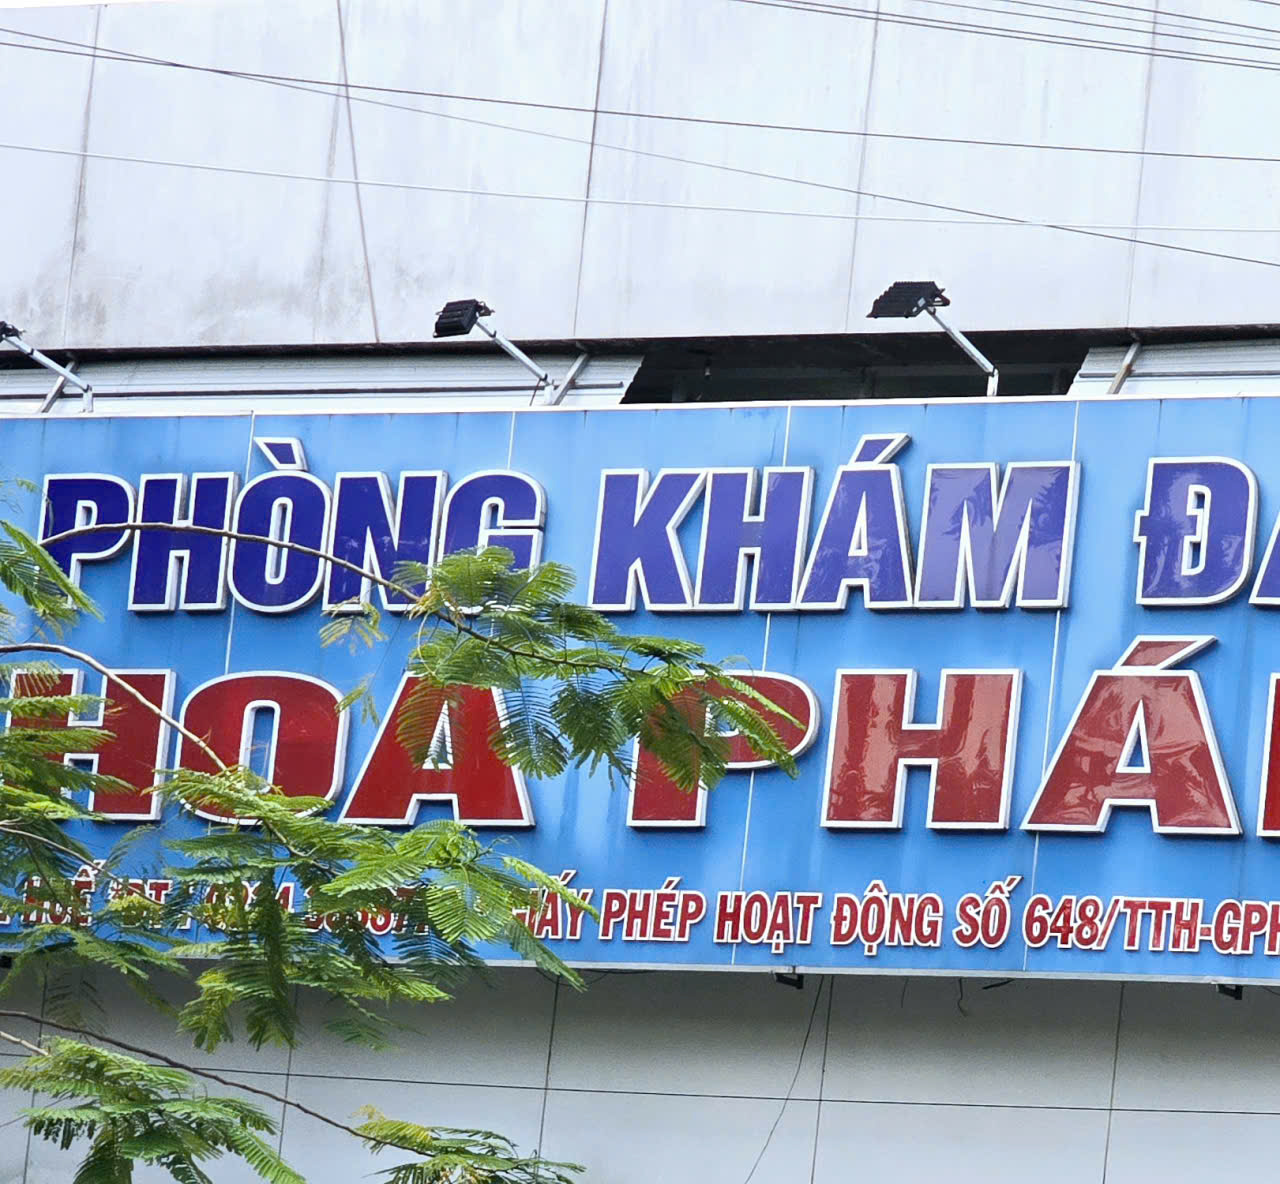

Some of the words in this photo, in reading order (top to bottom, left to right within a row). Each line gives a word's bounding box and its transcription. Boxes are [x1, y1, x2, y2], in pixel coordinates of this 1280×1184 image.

[38, 437, 546, 614] PHÒNG
[588, 433, 1081, 612] KHÁM
[599, 877, 706, 943] PHÉP
[714, 890, 822, 953] HOẠT
[830, 880, 944, 956] ĐỘNG
[953, 875, 1024, 949] SỐ
